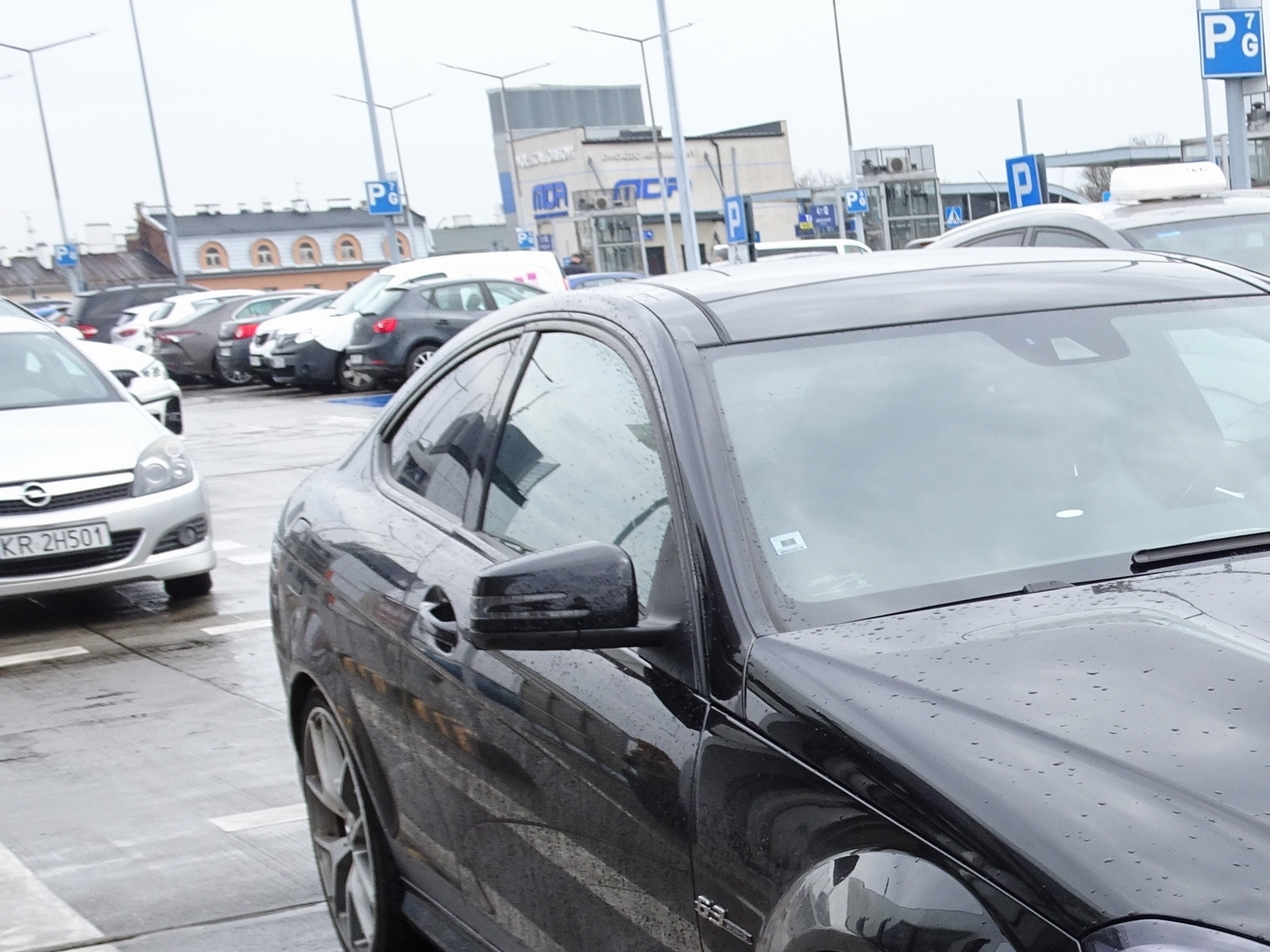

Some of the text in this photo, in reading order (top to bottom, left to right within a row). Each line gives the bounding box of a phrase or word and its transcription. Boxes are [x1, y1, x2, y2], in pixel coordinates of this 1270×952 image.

[1204, 12, 1255, 59] P 7
[1242, 32, 1259, 57] G
[368, 183, 386, 206] P
[1012, 162, 1032, 208] P
[388, 192, 399, 205] G
[847, 192, 858, 208] P
[727, 201, 741, 238] P
[518, 233, 528, 246] P
[56, 246, 69, 261] P
[1, 527, 103, 557] KR 2H501
